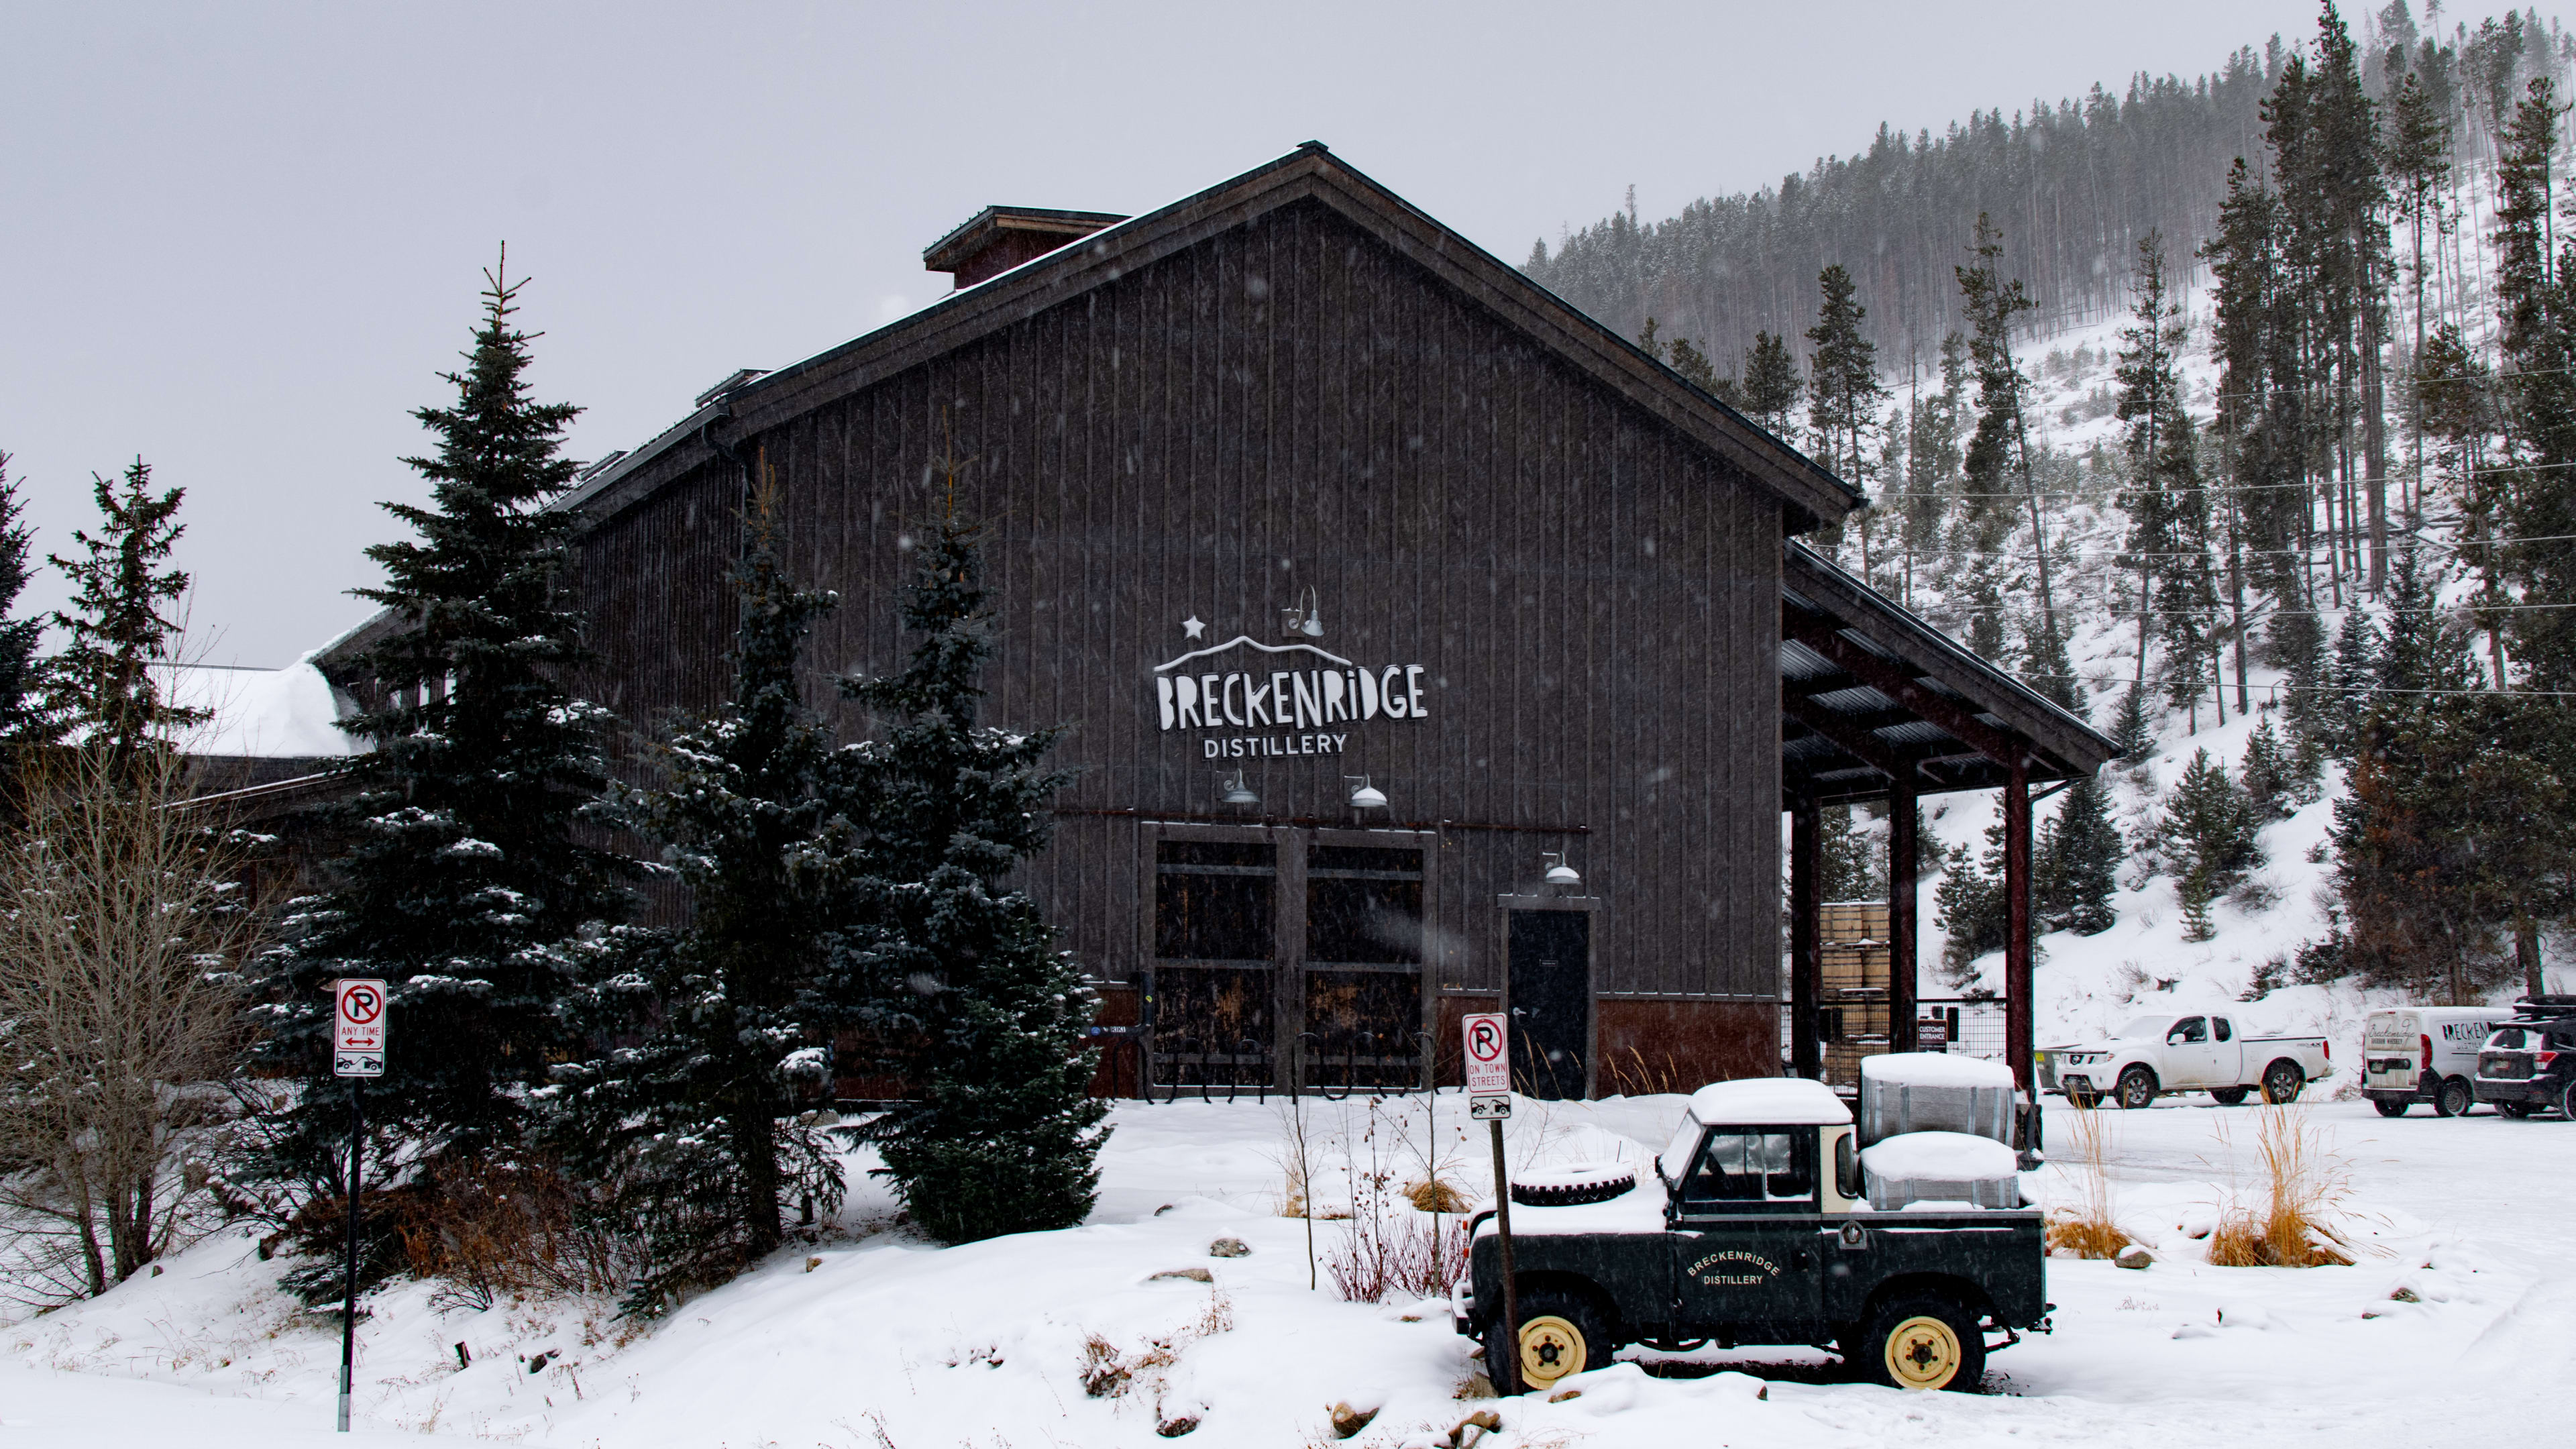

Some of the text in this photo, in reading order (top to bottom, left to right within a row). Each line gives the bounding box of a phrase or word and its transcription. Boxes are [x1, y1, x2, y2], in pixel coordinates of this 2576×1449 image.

[1205, 734, 1347, 759] DISTILLERY
[341, 1026, 380, 1036] ANY TIME
[1470, 1063, 1506, 1075] ON TOWN
[1472, 1075, 1505, 1087] STREETS
[1686, 1250, 1780, 1277] BRECKENRIDGE
[1704, 1275, 1763, 1285] DISTILLERY
